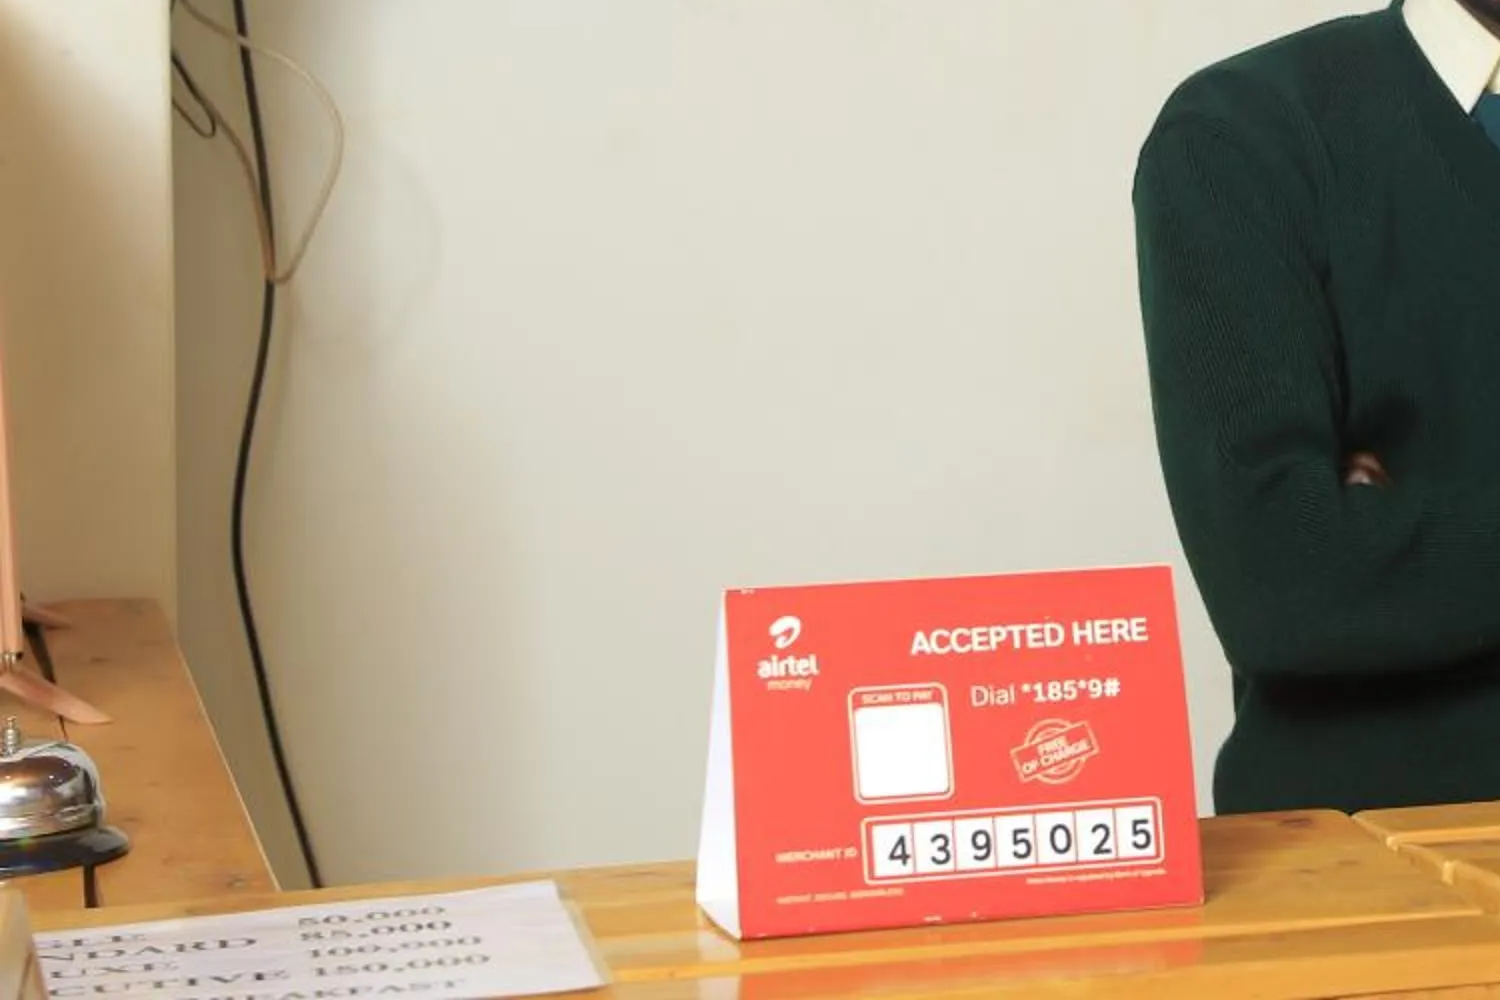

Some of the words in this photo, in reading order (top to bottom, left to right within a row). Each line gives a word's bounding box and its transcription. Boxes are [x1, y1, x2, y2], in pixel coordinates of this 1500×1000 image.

[910, 620, 1065, 656] ACCEPTED
[1072, 616, 1150, 646] HERE
[756, 653, 820, 679] airtel
[969, 683, 1016, 708] Dial
